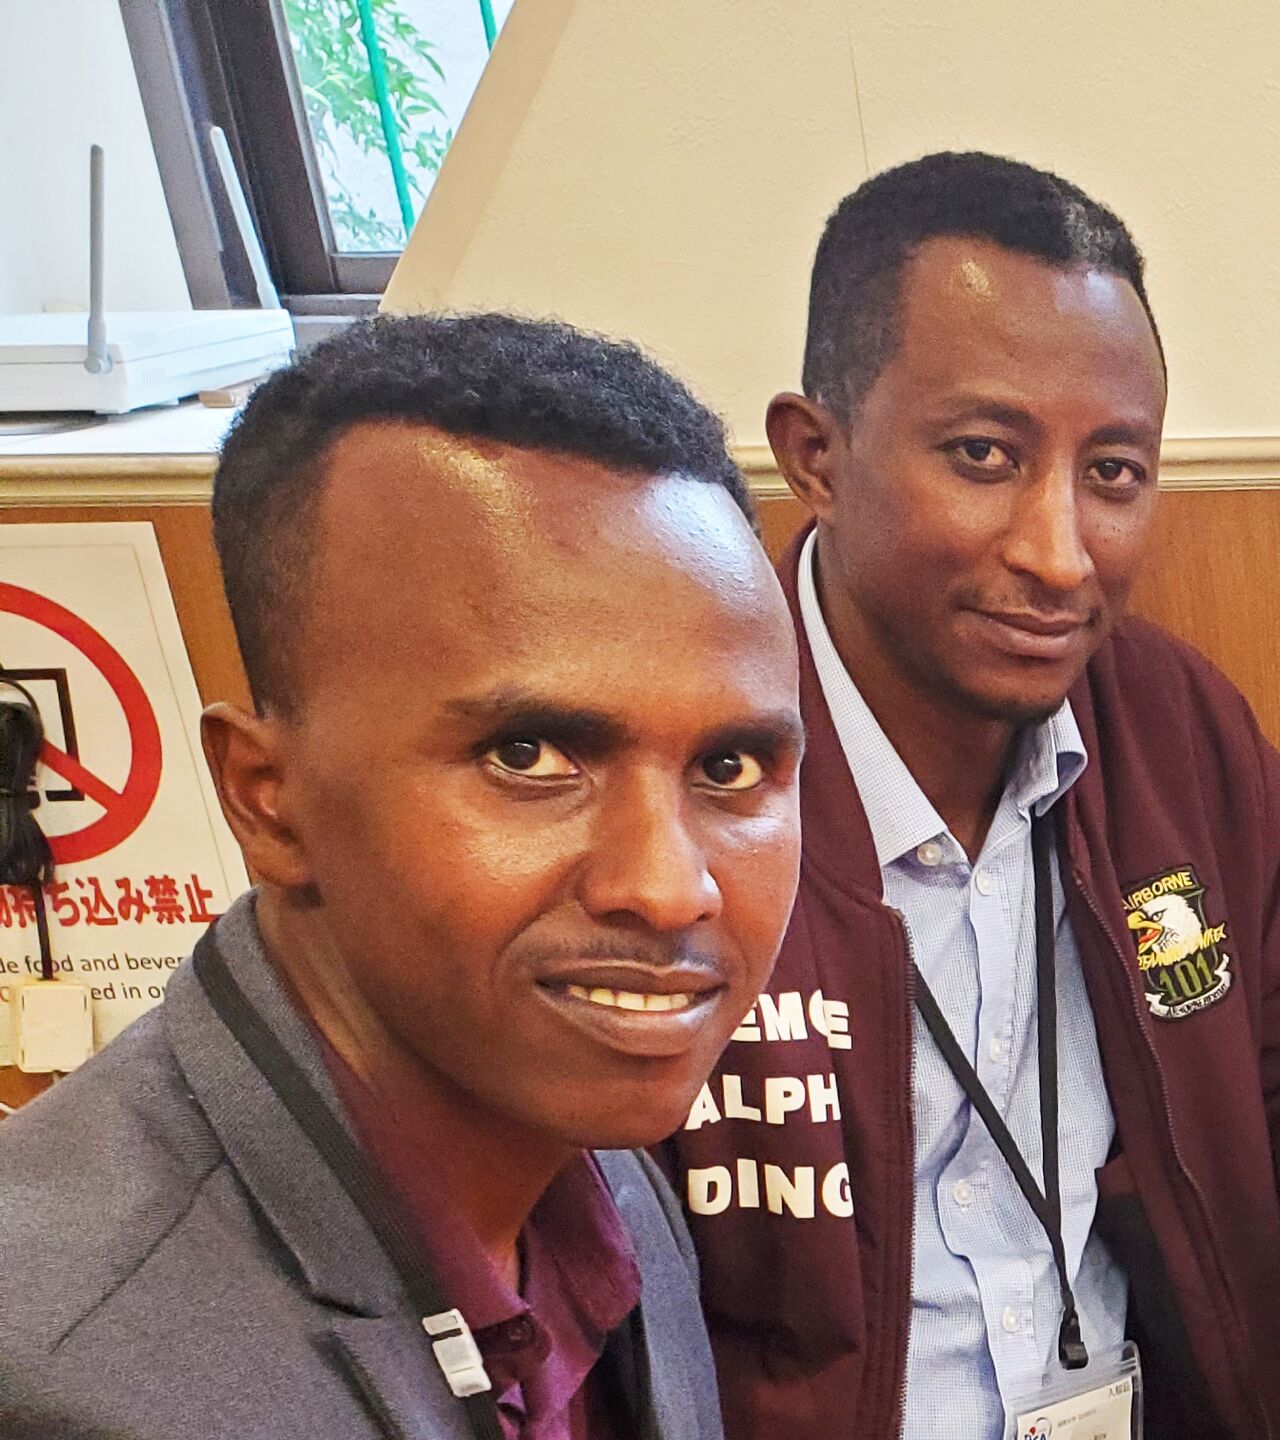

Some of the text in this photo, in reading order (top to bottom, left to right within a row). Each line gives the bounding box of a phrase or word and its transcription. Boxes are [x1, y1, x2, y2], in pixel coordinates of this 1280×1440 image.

[1122, 871, 1194, 911] AIRBORNE
[81, 953, 120, 971] and
[121, 981, 142, 998] in
[1159, 952, 1216, 1003] 101
